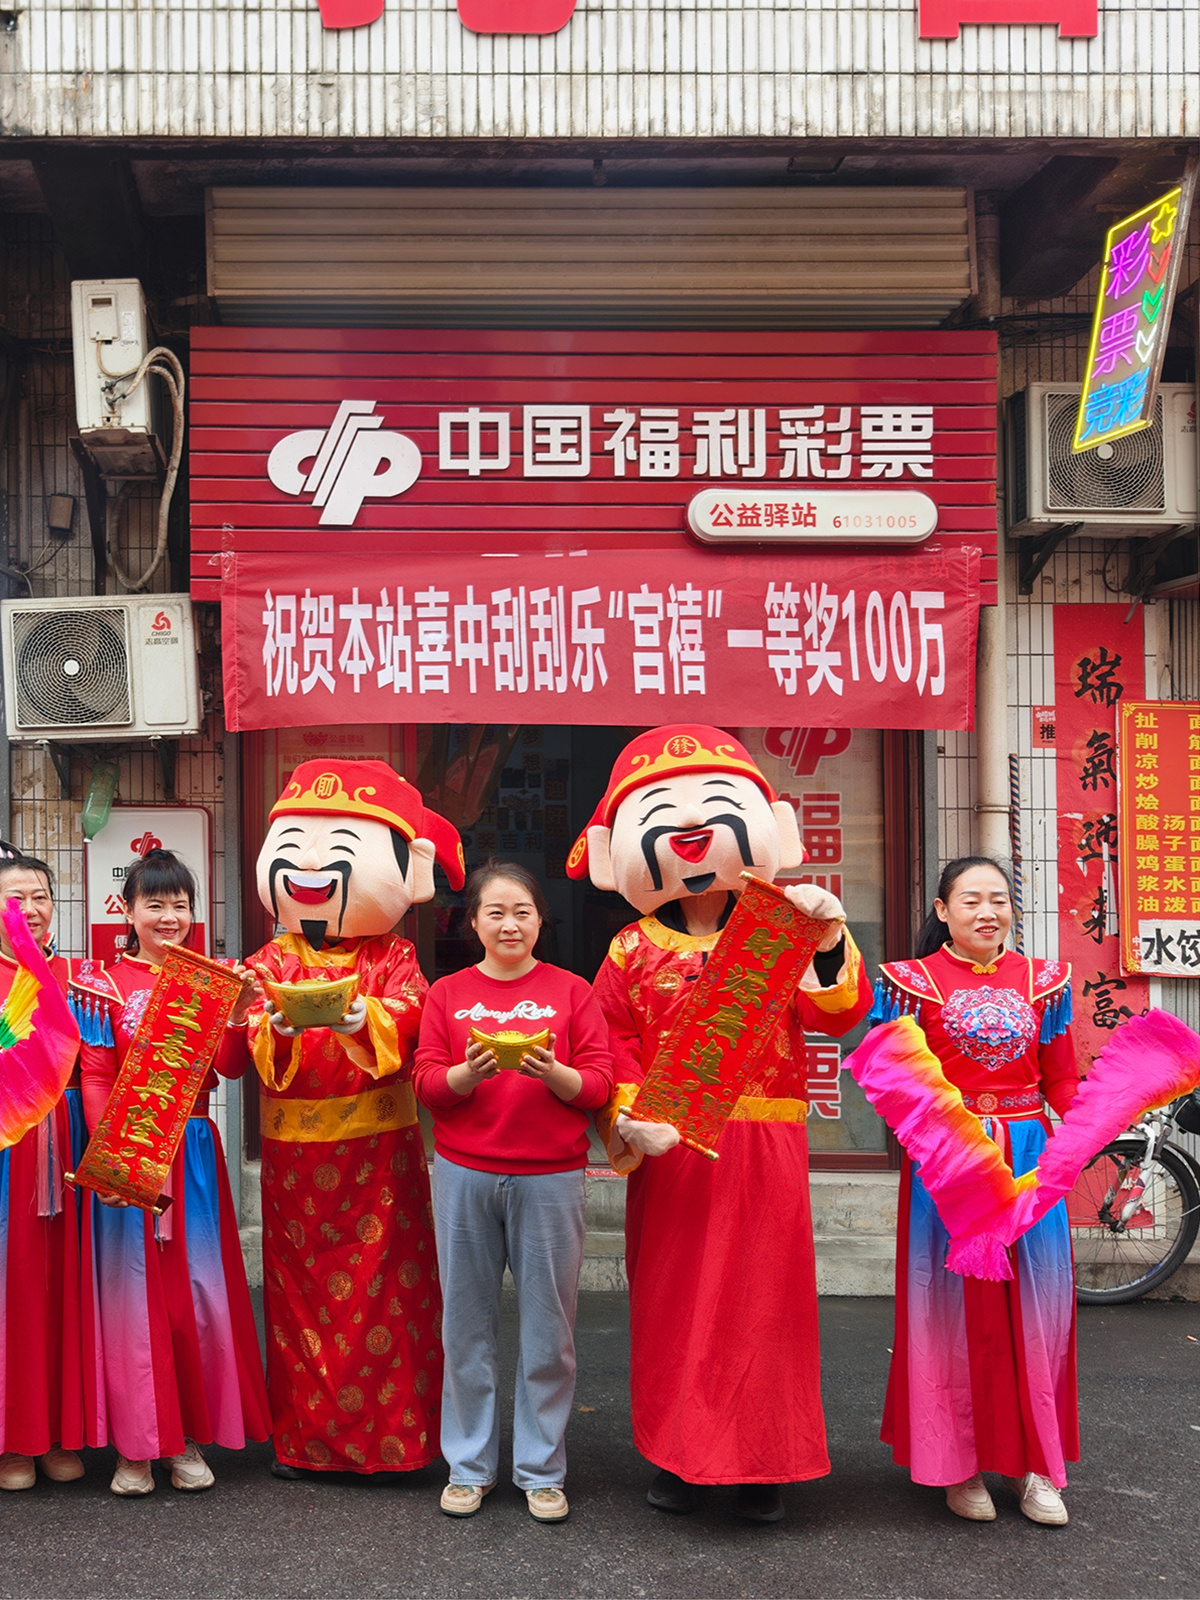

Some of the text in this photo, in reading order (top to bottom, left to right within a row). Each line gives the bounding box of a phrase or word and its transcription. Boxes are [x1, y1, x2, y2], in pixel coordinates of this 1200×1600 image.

[1091, 221, 1151, 379] 彩票
[1079, 366, 1151, 442] 竞彩
[438, 404, 934, 478] 中国福利彩票
[709, 502, 918, 529] 公益驿站 61031005
[670, 737, 697, 755] 發
[1039, 723, 1056, 740] 推
[316, 776, 336, 797] 財
[119, 992, 203, 1150] 生意興隆
